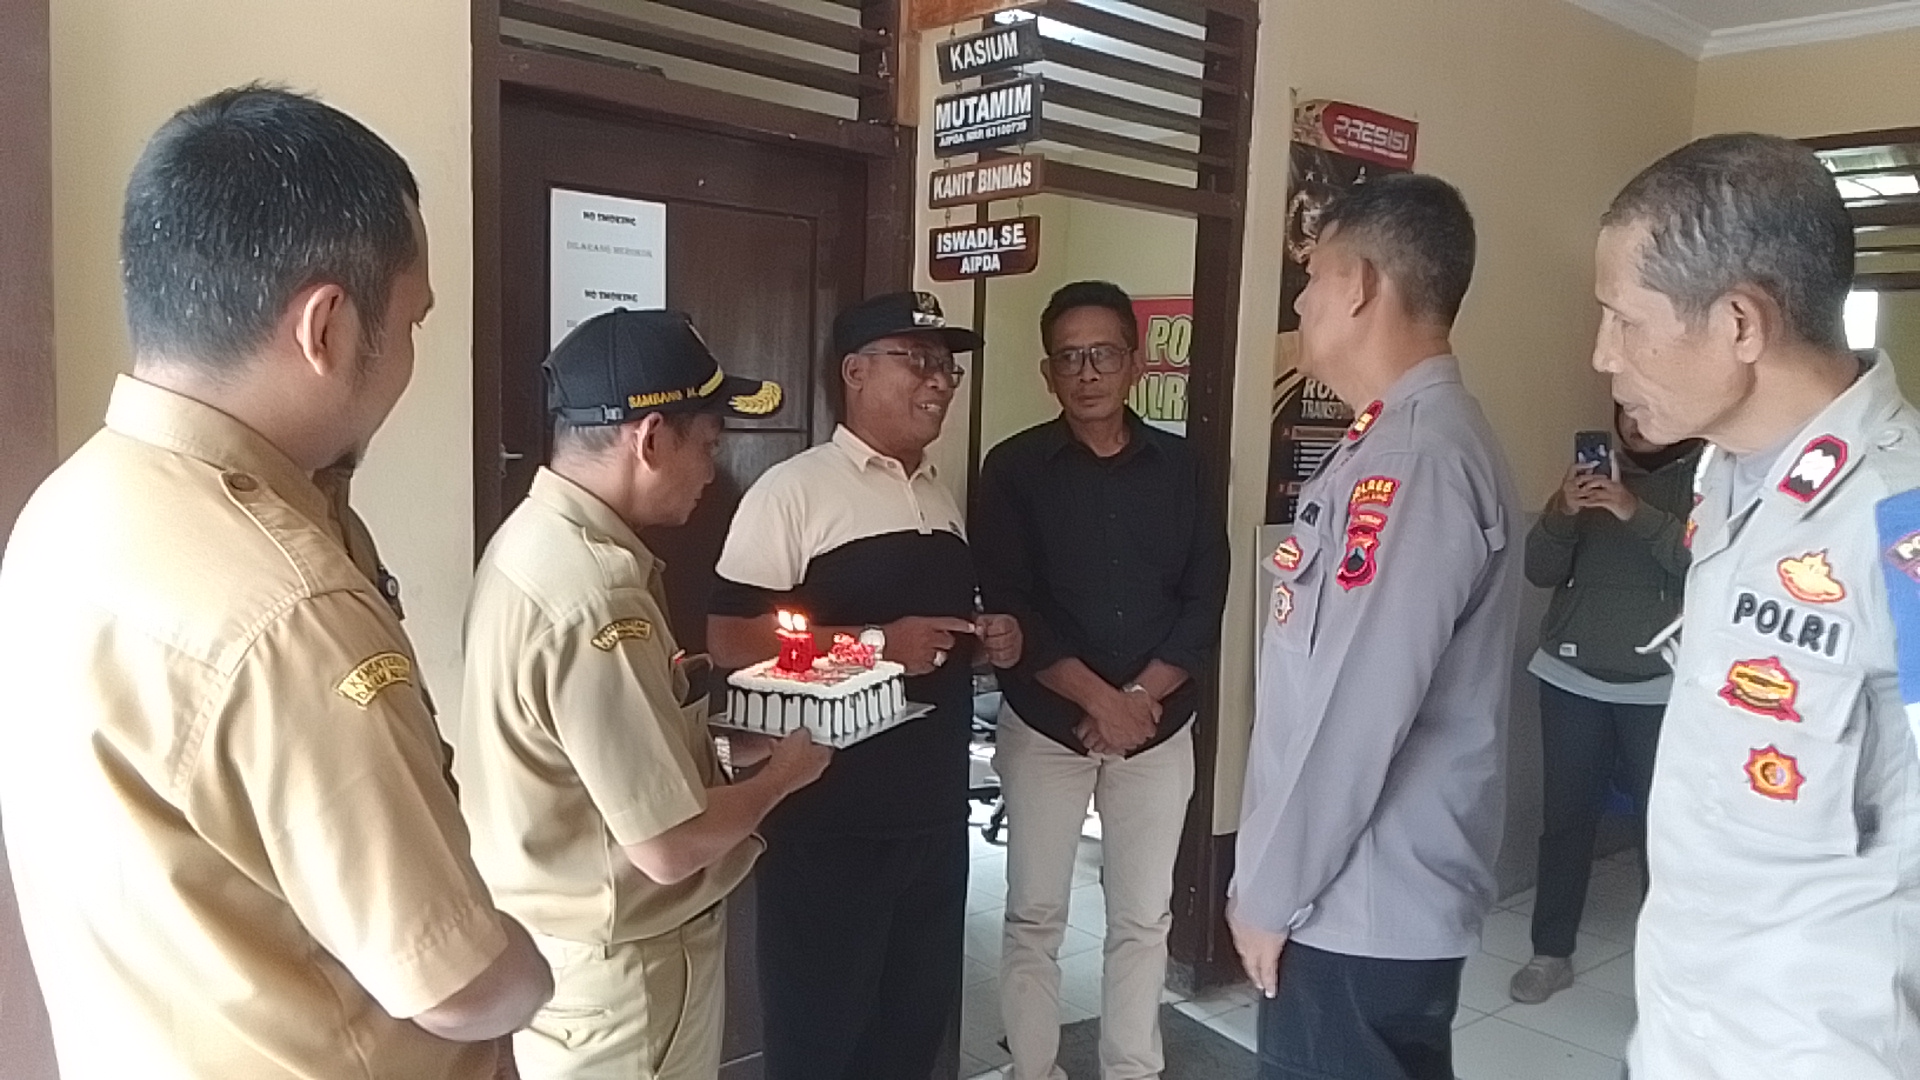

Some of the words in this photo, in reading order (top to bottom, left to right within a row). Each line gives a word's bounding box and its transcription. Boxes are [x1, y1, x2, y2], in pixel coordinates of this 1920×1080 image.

[950, 30, 1019, 71] KASIUM
[936, 83, 1032, 130] MUTAMIM
[1333, 115, 1410, 152] PRESISI
[934, 171, 975, 200] KANIT
[977, 161, 1032, 194] BINMAS
[583, 211, 595, 221] NO
[937, 226, 998, 253] ISWADI,
[1000, 223, 1026, 245] SE
[959, 253, 1001, 274] AIPDA
[584, 289, 597, 300] NO
[1733, 592, 1840, 657] POLRI
